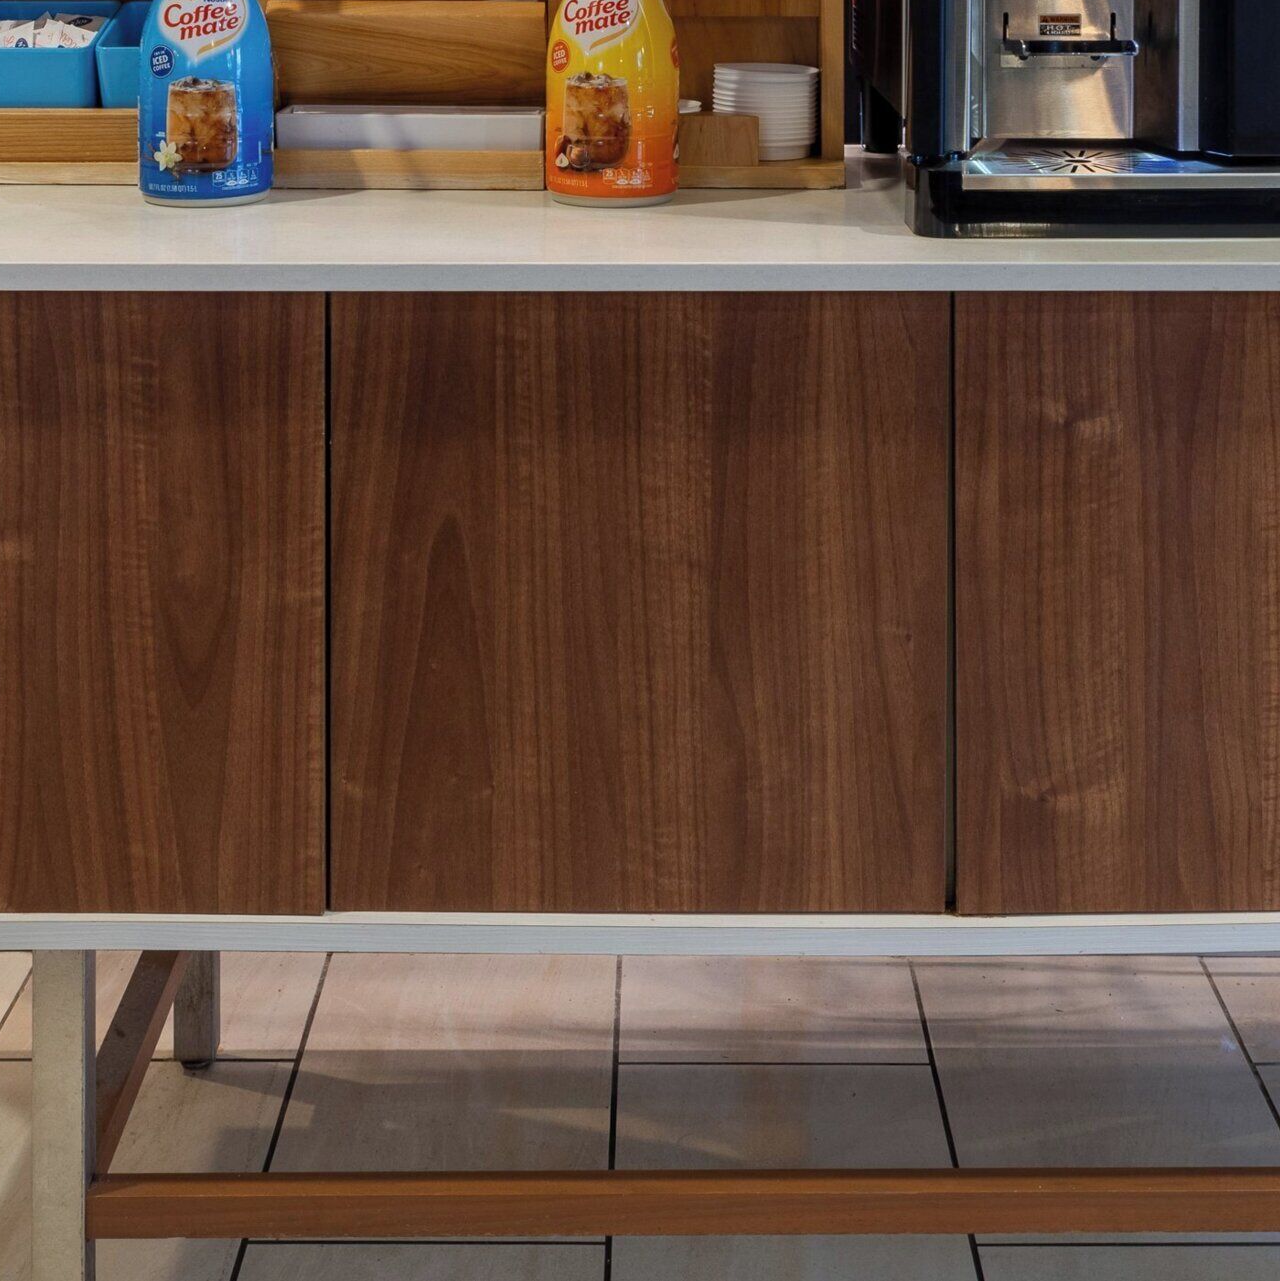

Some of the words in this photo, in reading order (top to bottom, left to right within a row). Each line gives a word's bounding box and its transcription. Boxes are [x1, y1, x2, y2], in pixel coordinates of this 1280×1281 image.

[163, 3, 237, 28] Coffee
[575, 10, 631, 35] mate
[180, 16, 239, 40] mate
[152, 55, 168, 64] ICED
[553, 49, 565, 59] ICED
[153, 63, 171, 72] COFFEE
